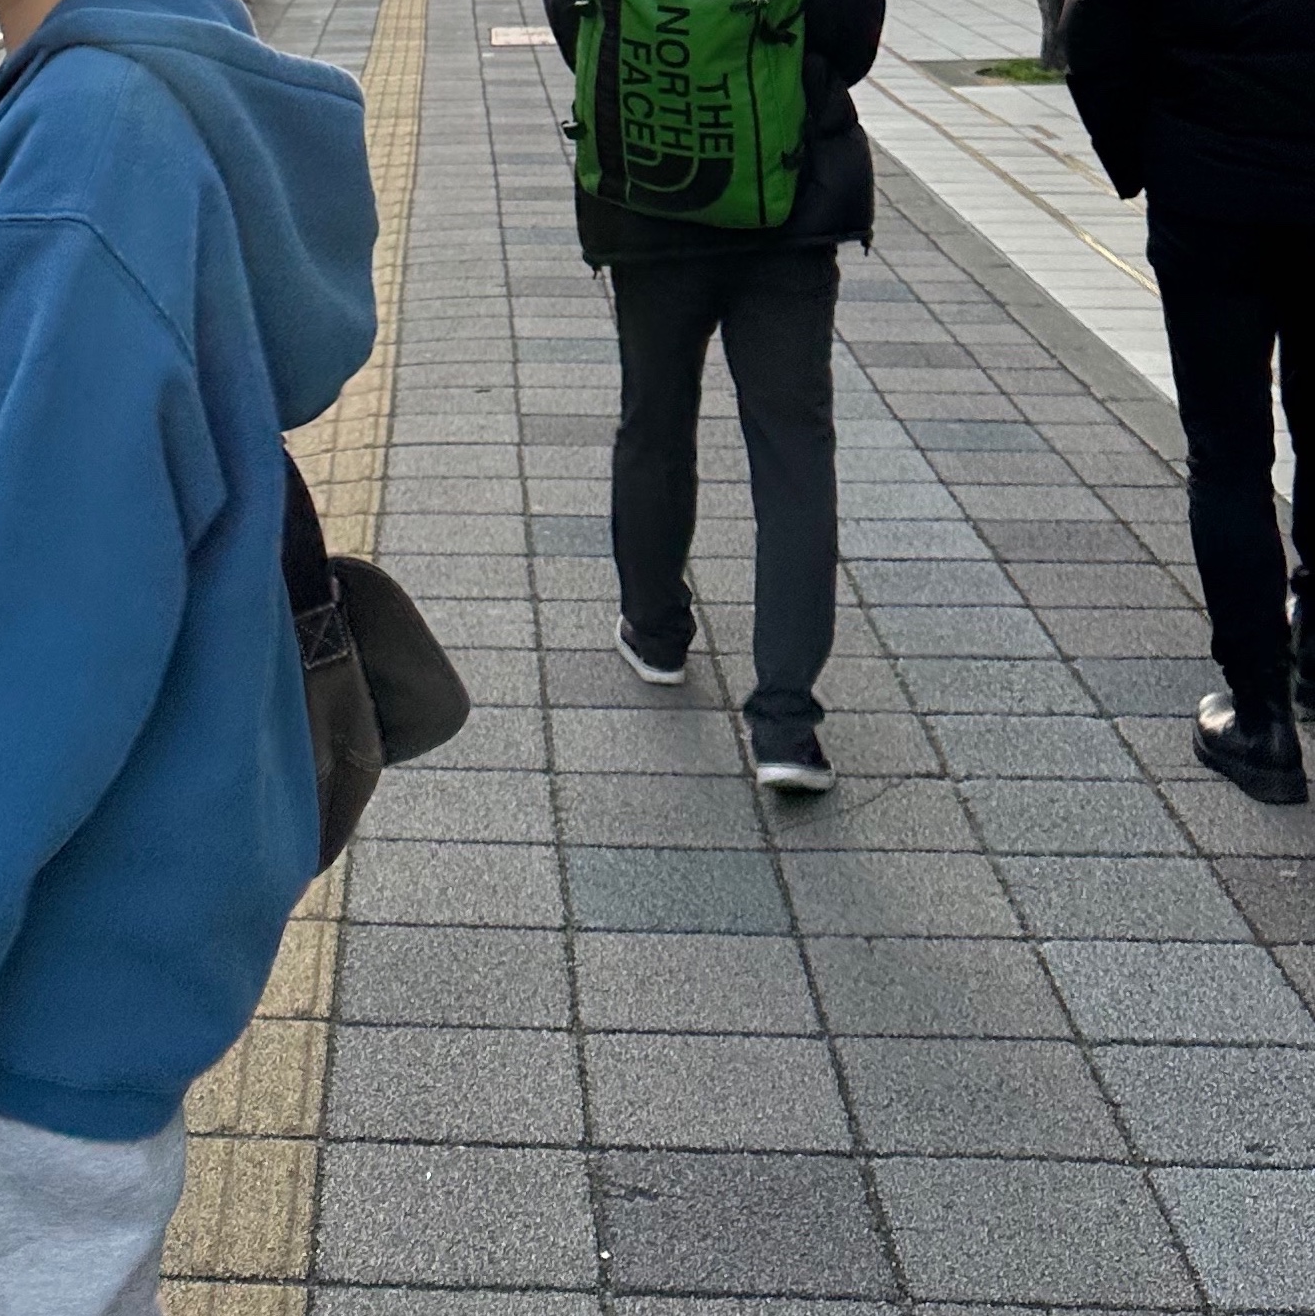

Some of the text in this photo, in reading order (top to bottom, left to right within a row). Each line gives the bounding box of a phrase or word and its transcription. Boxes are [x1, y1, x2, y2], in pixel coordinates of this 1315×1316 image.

[620, 37, 656, 148] FACE
[656, 4, 694, 152] NORTH
[696, 73, 734, 154] THE
